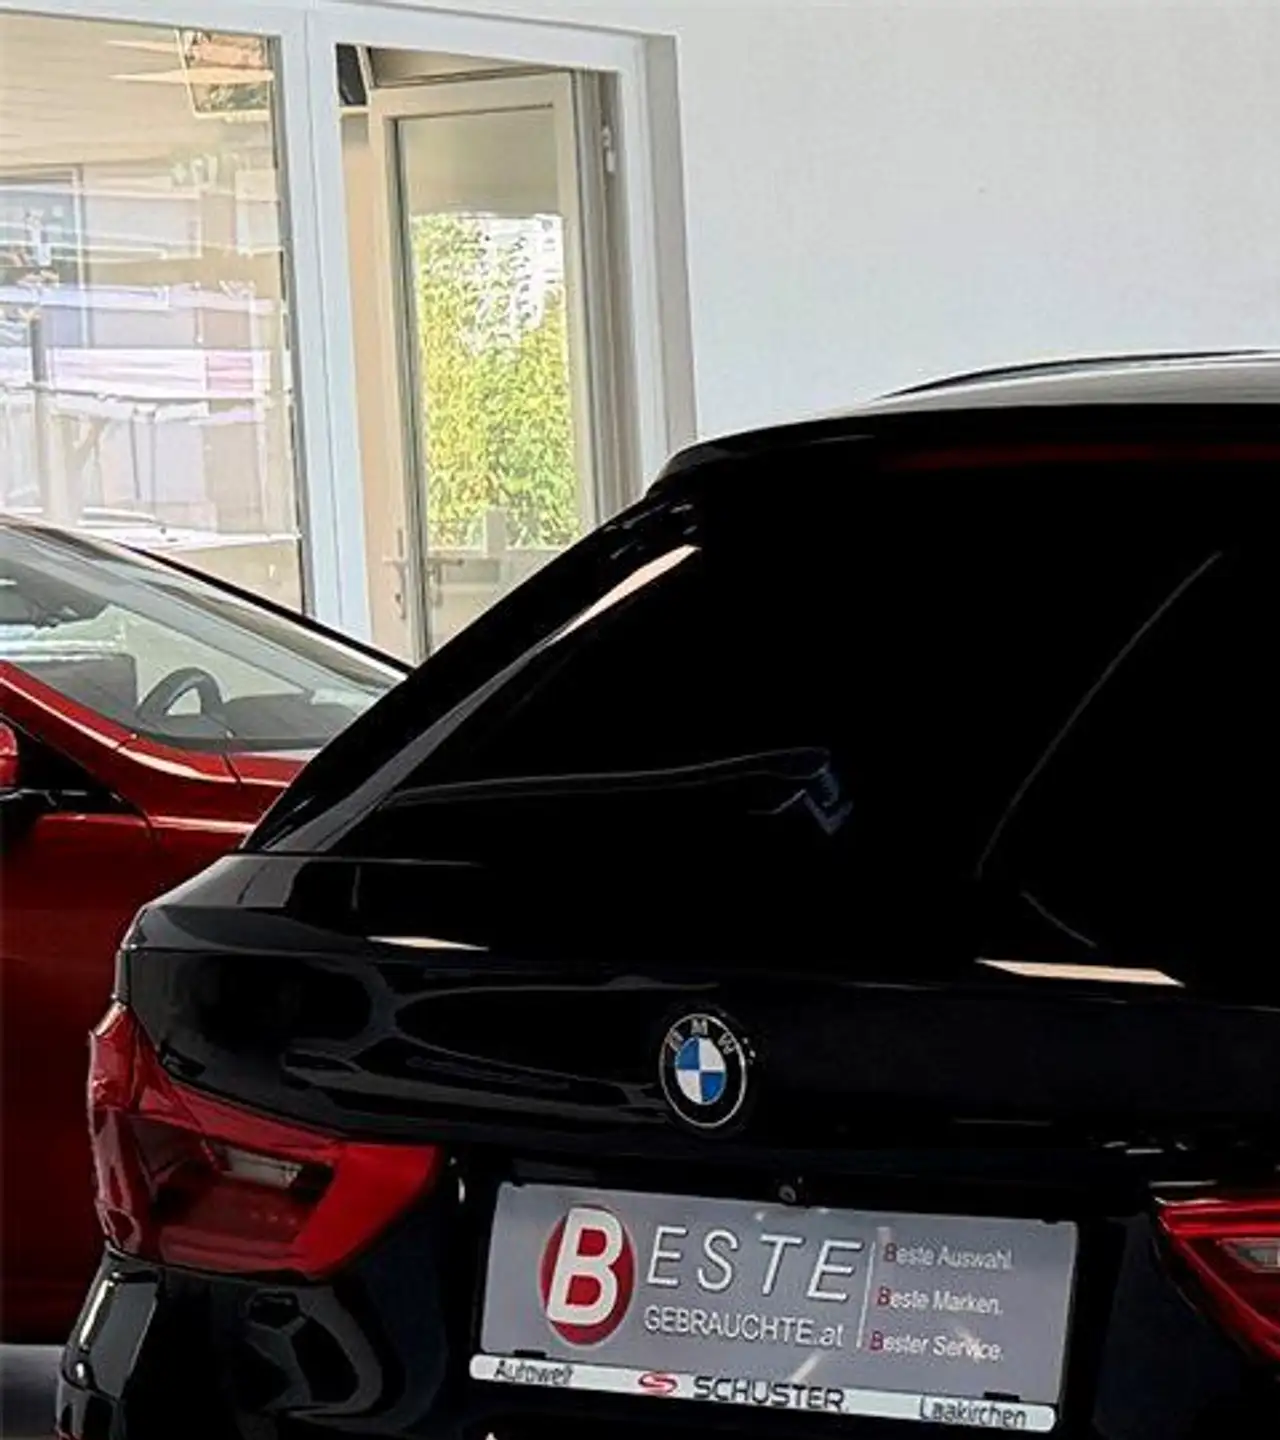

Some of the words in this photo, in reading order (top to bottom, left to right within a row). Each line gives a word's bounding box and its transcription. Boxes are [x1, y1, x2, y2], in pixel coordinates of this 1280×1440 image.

[883, 1243, 934, 1267] Beste
[877, 1286, 930, 1309] Beste
[870, 1331, 930, 1354] Bester
[919, 1396, 1028, 1428] Laakirchen
